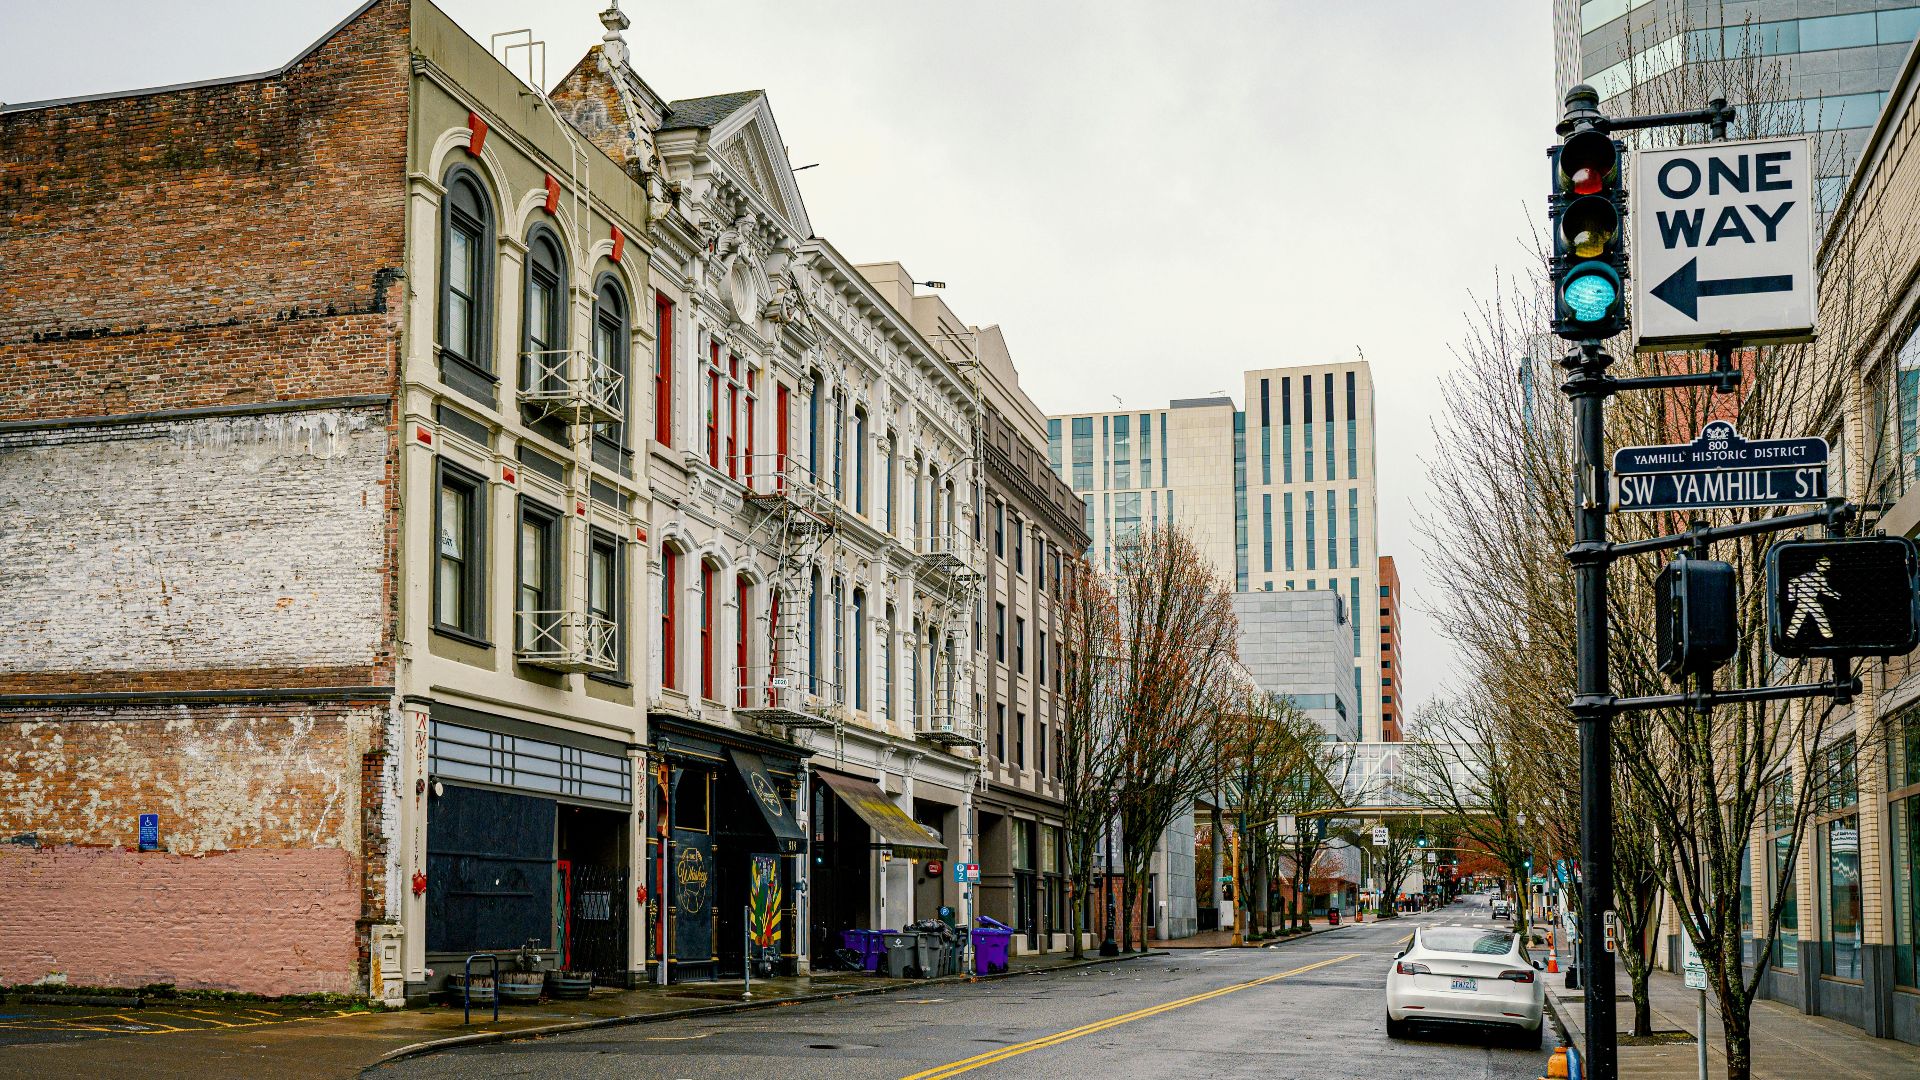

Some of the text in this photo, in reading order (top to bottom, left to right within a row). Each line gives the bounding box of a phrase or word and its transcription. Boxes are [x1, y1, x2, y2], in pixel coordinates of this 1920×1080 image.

[1658, 151, 1792, 199] ONE
[1656, 201, 1796, 249] WAY
[1634, 446, 1806, 465] YAMHILL HISTORIC DISTRICT
[1708, 440, 1728, 450] 800
[1620, 468, 1822, 506] SW YAMHILL ST
